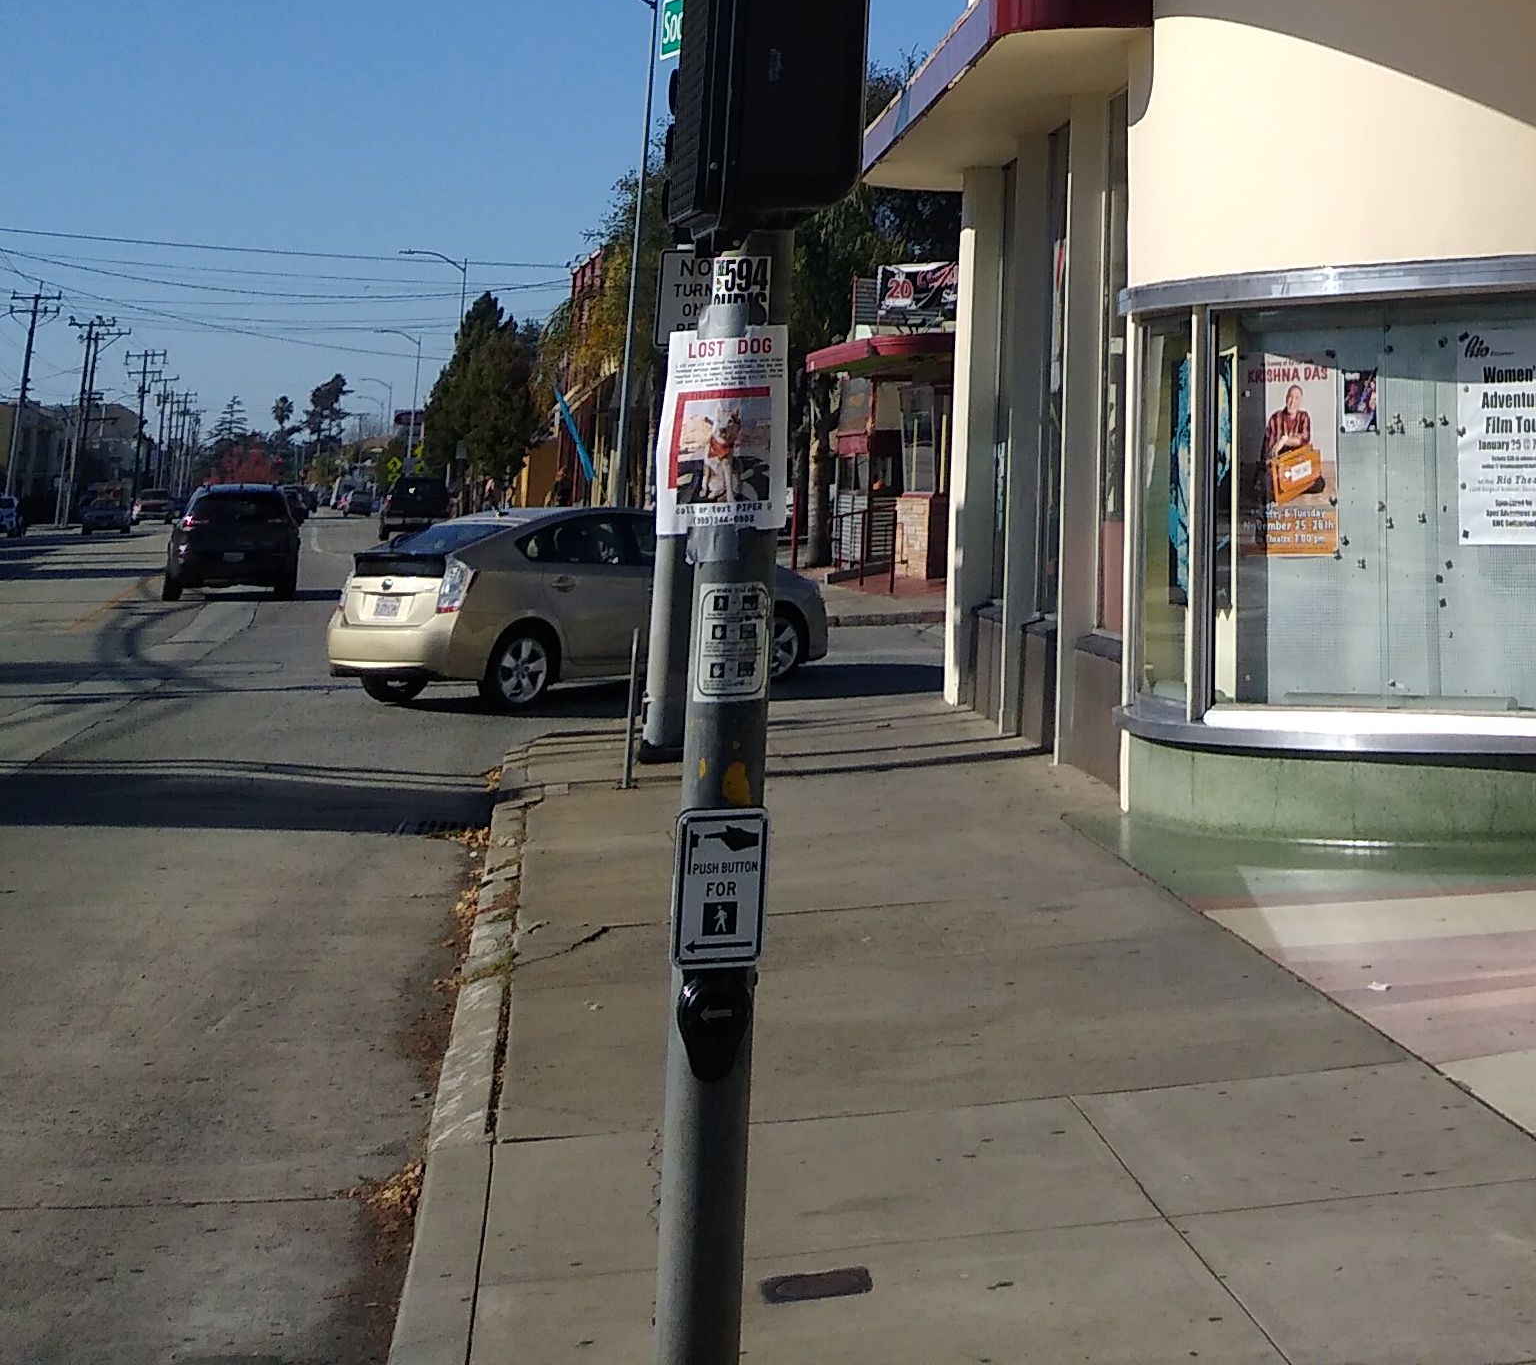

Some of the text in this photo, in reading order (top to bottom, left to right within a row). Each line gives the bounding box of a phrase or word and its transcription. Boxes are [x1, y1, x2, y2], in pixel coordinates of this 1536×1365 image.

[679, 258, 711, 277] NO
[724, 257, 768, 292] 594
[688, 337, 772, 359] LOST DOG
[1464, 334, 1490, 359] Rio
[1485, 415, 1513, 434] Film
[1478, 439, 1510, 451] January
[692, 860, 759, 875] PUSH BUTTON
[706, 881, 737, 897] FOR
